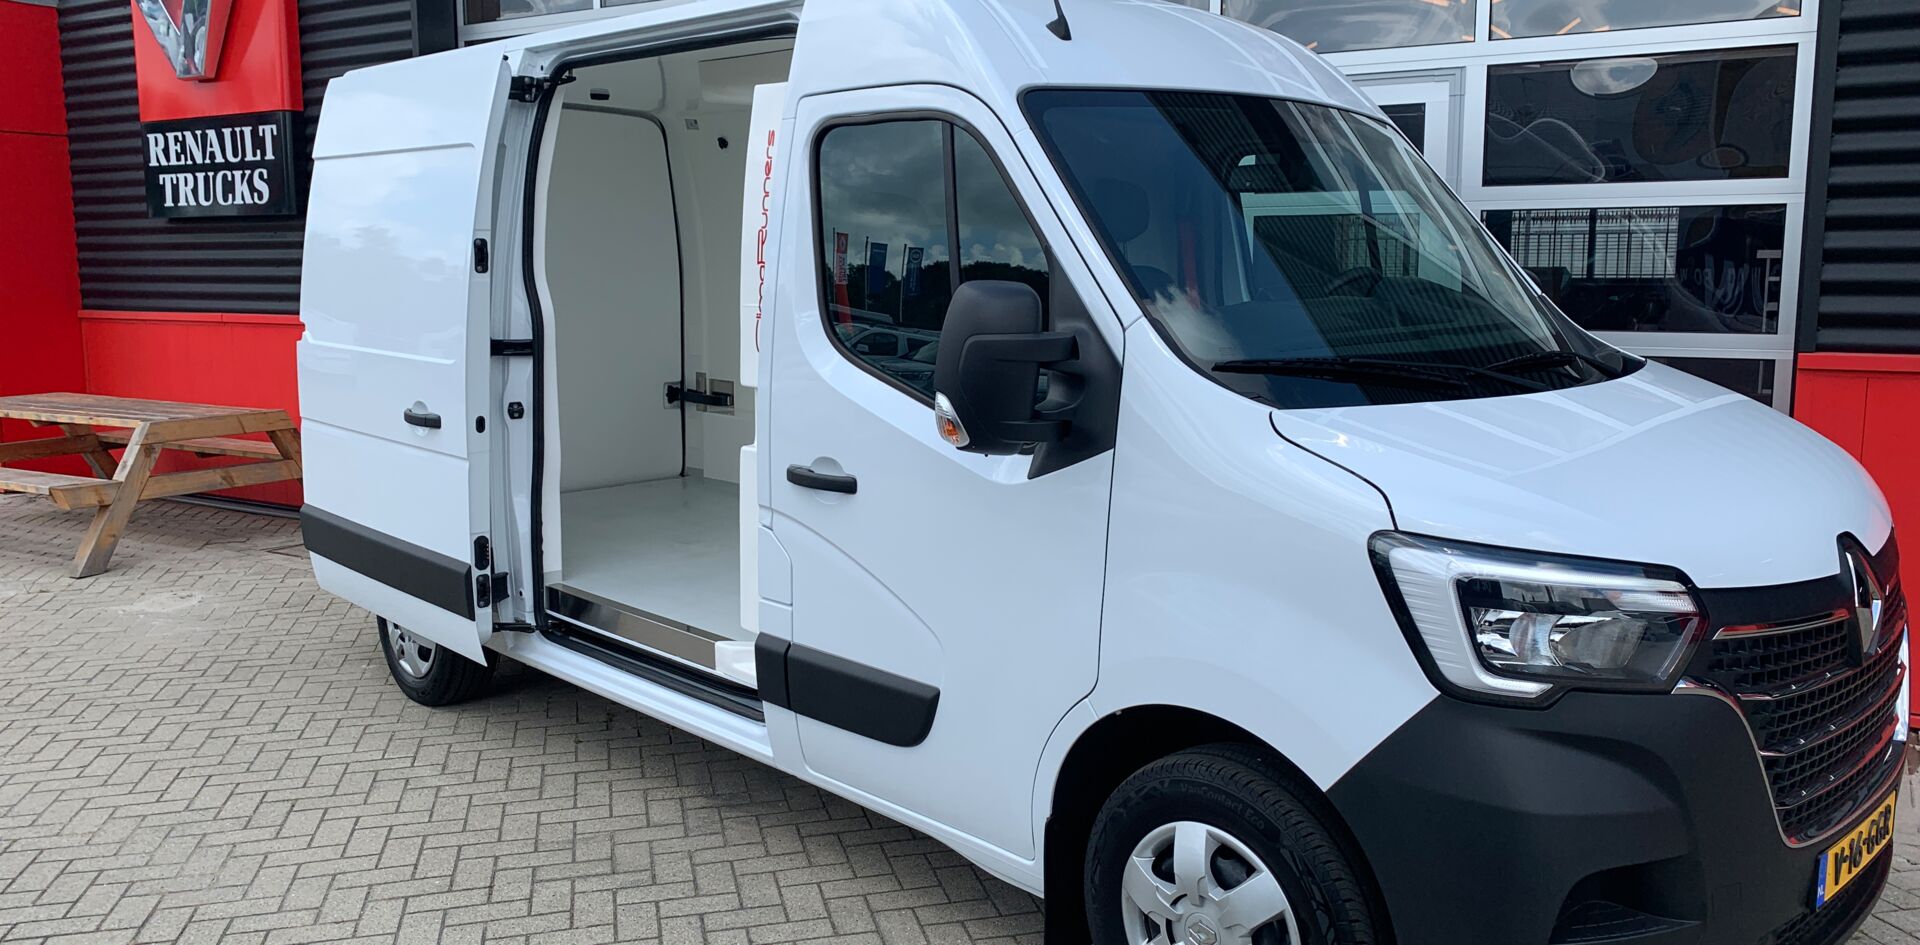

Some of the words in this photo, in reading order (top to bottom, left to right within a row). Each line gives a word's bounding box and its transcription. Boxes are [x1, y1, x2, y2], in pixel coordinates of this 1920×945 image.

[146, 124, 278, 167] RENAULT
[158, 168, 270, 207] TRUCKS
[1244, 807, 1265, 830] Eco
[1817, 884, 1825, 898] NL
